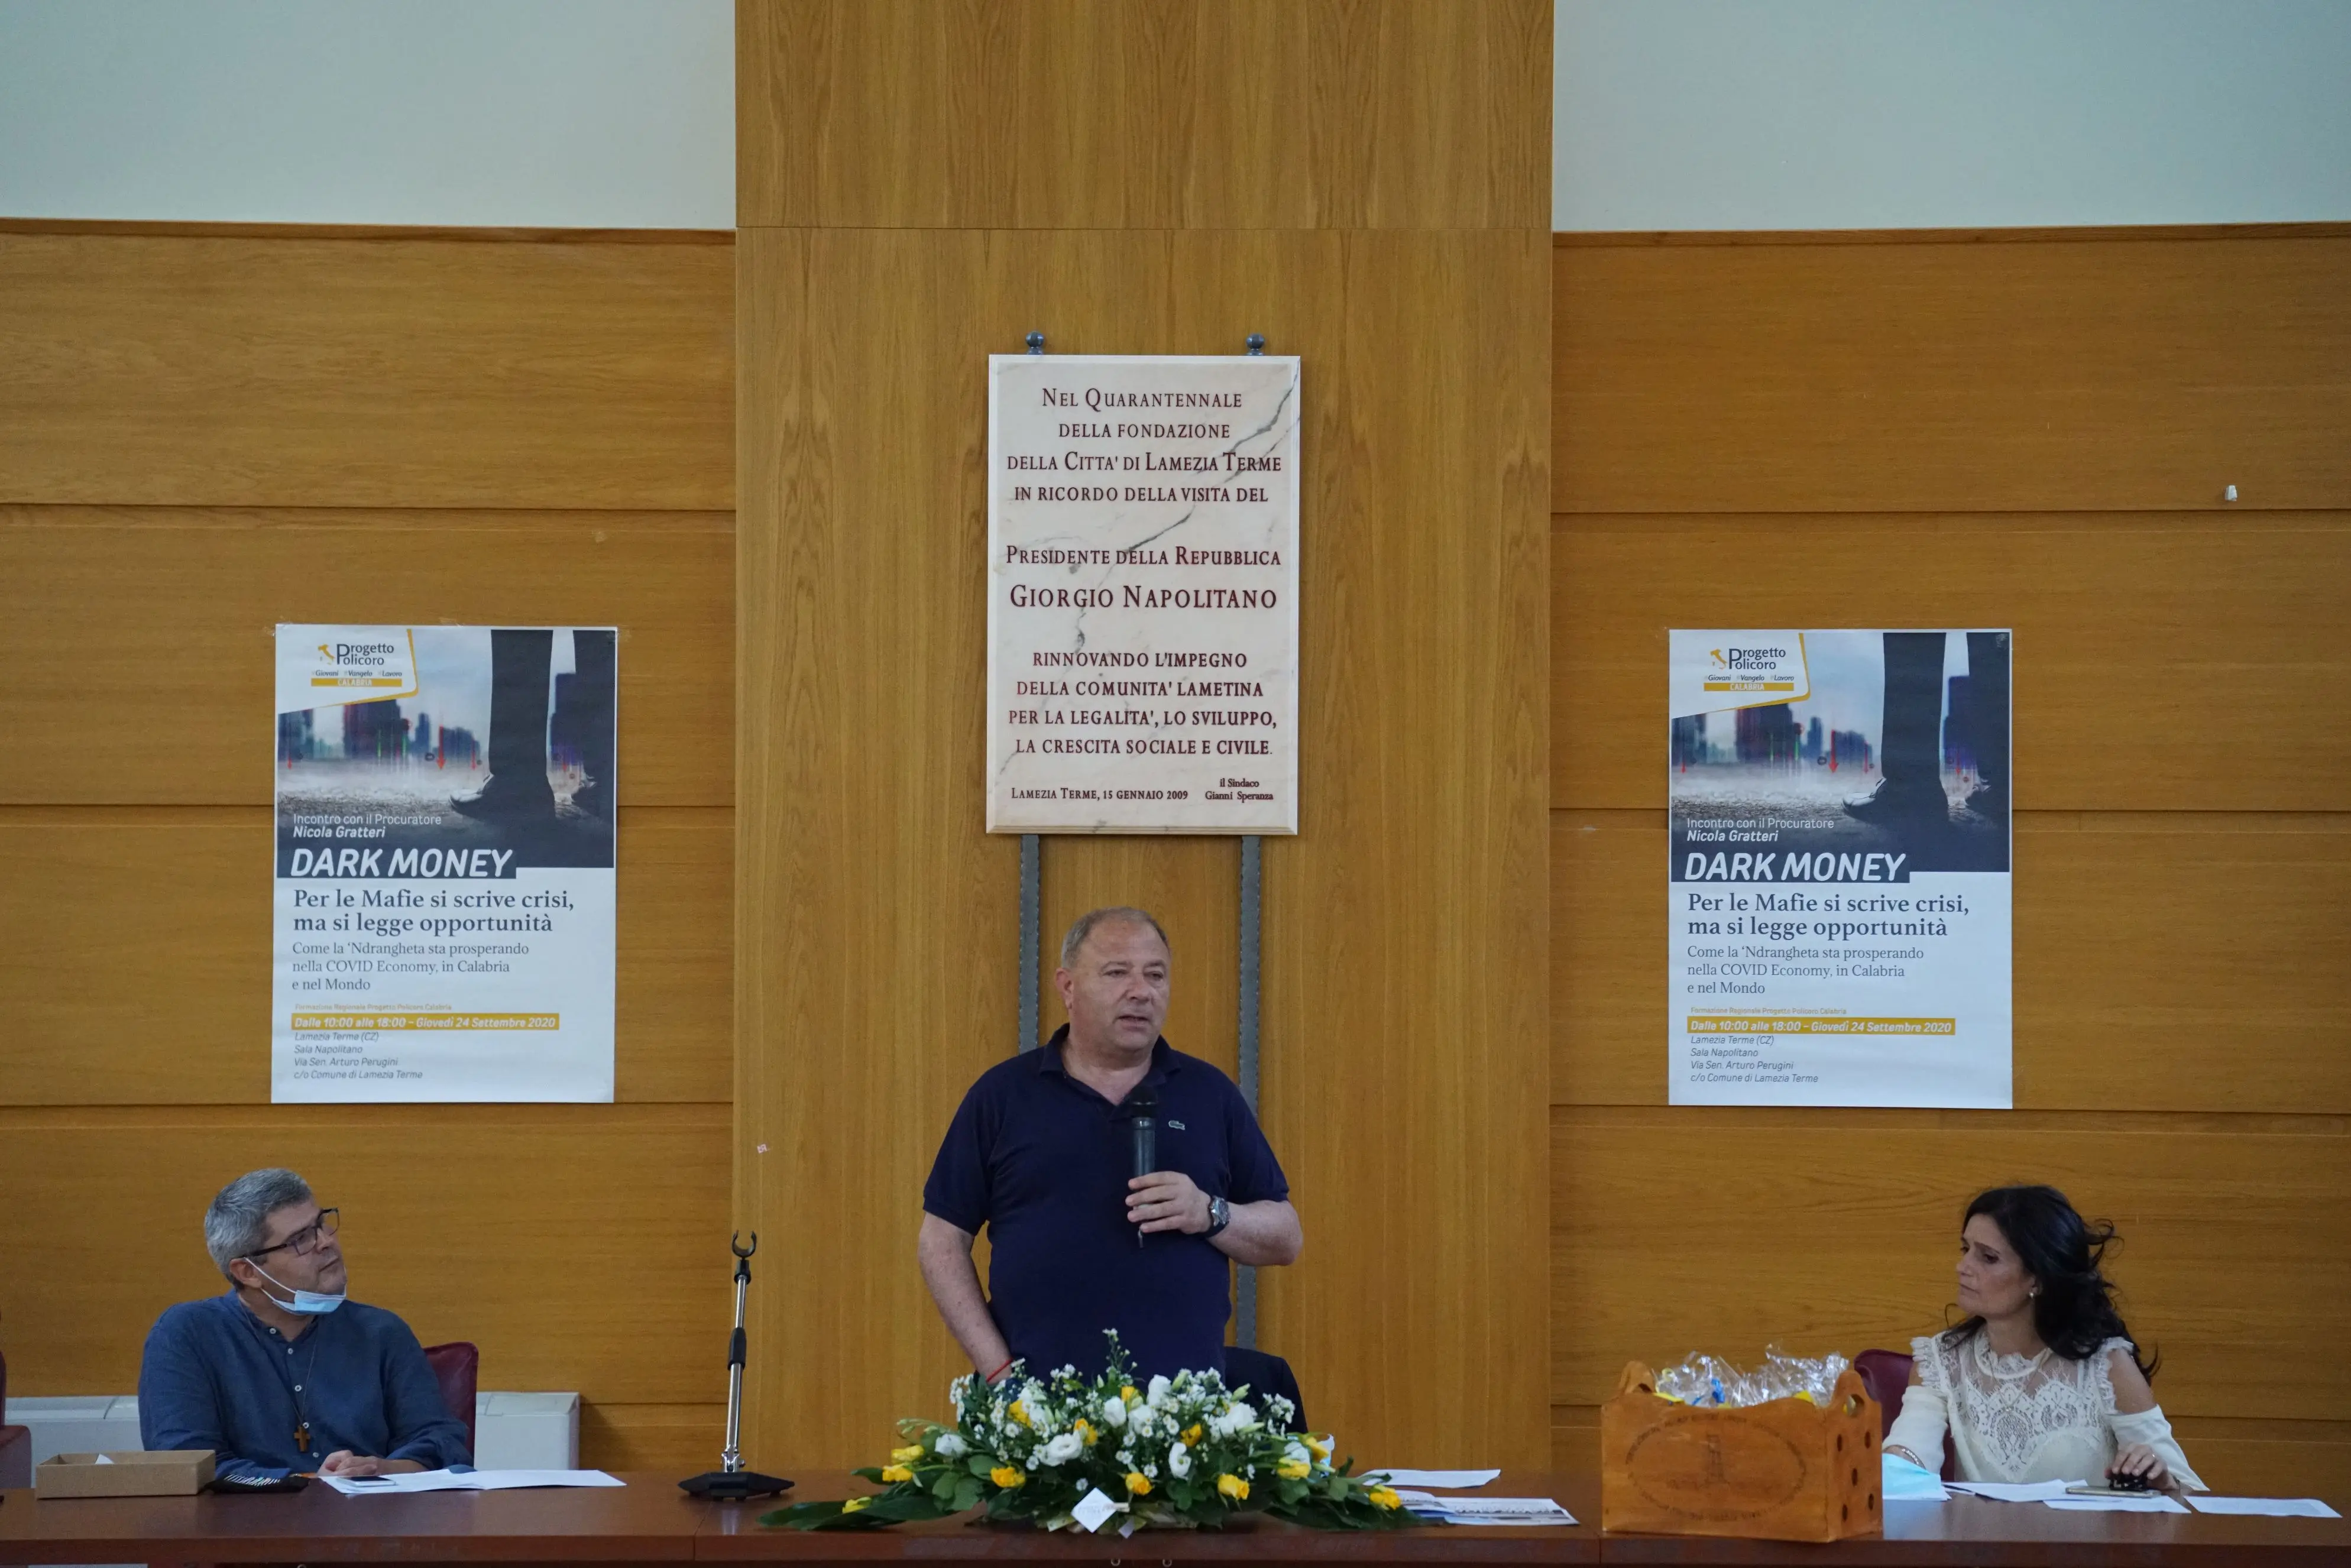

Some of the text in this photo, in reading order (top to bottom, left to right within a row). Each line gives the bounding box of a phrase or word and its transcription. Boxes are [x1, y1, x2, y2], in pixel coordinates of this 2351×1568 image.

[1042, 388, 1242, 412] NEL QUARANTENNALE
[1059, 423, 1230, 439] DELLA FONDAZIONE
[1007, 451, 1281, 472] DELLA CITTA' DI LAMEZIA TERME
[1015, 487, 1268, 502] IN RICORDO DELLA VISITA DEL
[1006, 545, 1281, 565] PRESIDENTE DELLA REPUBBLICA
[1010, 584, 1277, 609] GIORGIO NAPOLITANO
[336, 643, 394, 656] Progetto
[336, 643, 385, 666] Policoro
[1728, 647, 1787, 661] Progetto
[1033, 651, 1247, 668] RINNOVANDO L'IMPEGNO
[1728, 648, 1777, 670] Policoro
[337, 678, 373, 686] CALABRIA
[1016, 681, 1264, 697] DELLA COMUNITA' LAMETINA
[1730, 683, 1765, 691] CALABRIA
[1009, 710, 1277, 729] PER LA LEGALITA', LO SVILUPPO,
[1015, 739, 1036, 753] LA
[1042, 739, 1121, 754] CRESCITA
[1126, 740, 1196, 754] SOCIALE
[1202, 740, 1211, 754] E
[1219, 777, 1260, 788] il Sindaco
[1011, 787, 1189, 801] LAMEZIA TERME, 15 GENNAIO 2009
[1204, 791, 1274, 804] Gianni Speranza
[293, 813, 442, 825] Incontro con il Procuratore
[1687, 817, 1834, 828] Incontro con il Procuratore
[293, 825, 386, 838] Nicola Gratteri
[1686, 830, 1779, 842] Nicola Gratteri
[290, 847, 513, 878] DARK MONEY
[1685, 851, 1906, 882] DARK MONEY
[294, 889, 574, 911] Per le Mafie si scrive crisi,
[1688, 892, 1969, 916] Per le Mafie si scrive crisi,
[294, 912, 553, 937] ma si legge opportunità
[1688, 916, 1948, 941] ma si legge opportunità
[292, 942, 330, 954] Come
[333, 942, 344, 954] la
[428, 945, 446, 954] sta
[449, 942, 529, 958] prosperando
[1688, 945, 1724, 958] Come
[1728, 945, 1739, 958] la
[1822, 948, 1841, 958] sta
[1843, 947, 1924, 962] prosperando
[293, 960, 510, 975] nella COVID Economy, in Calabria
[1687, 963, 1905, 979] nella COVID Economy, in Calabria
[292, 978, 371, 990] e nel Mondo
[1687, 981, 1765, 994] e nel Mondo
[1691, 1020, 1952, 1033] Dalle 10:00 alle 18:00 Giovedì 24 Settembre 2020
[1691, 1035, 1774, 1046] Lamezia Terme (CZ)
[1690, 1048, 1759, 1058] Sala Napolitano
[1691, 1060, 1704, 1070] Via
[1725, 1060, 1755, 1070] Arturo
[1757, 1061, 1793, 1071] Perugini
[1691, 1073, 1819, 1083] c/o Comune di Lamezia Terme
